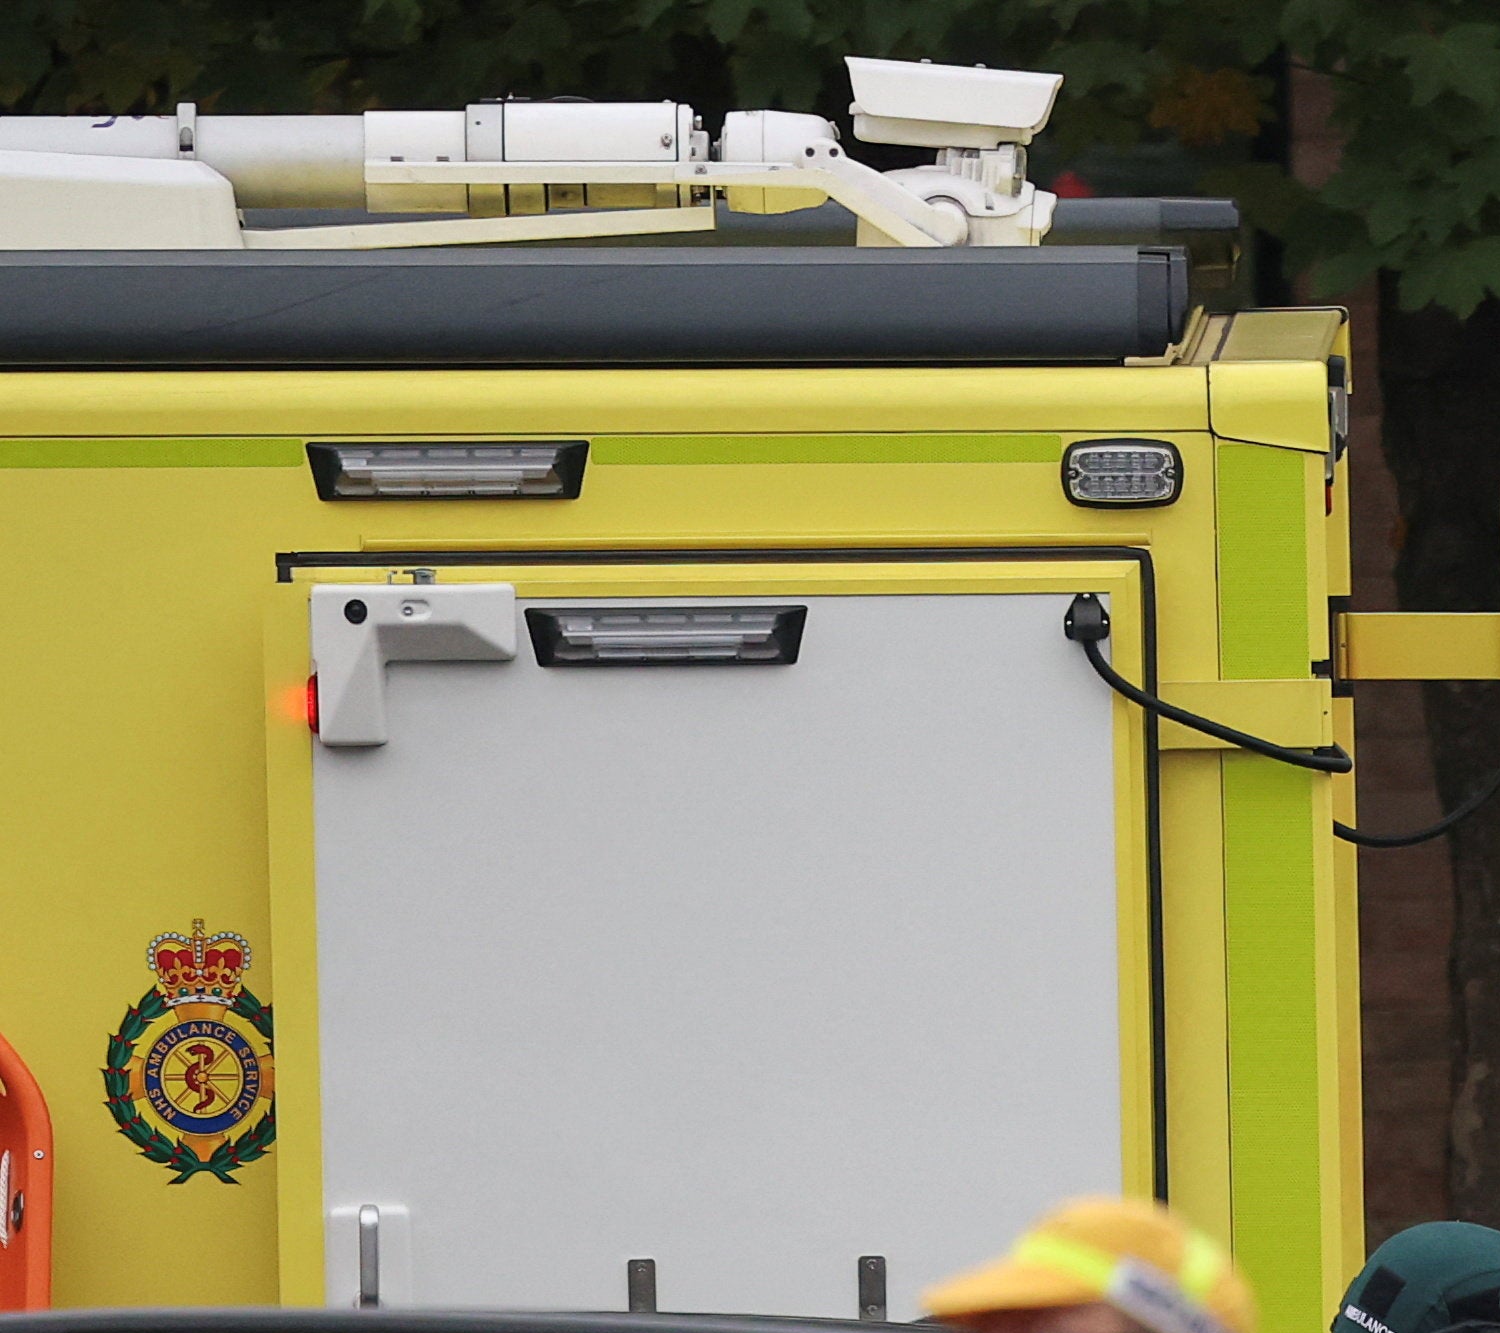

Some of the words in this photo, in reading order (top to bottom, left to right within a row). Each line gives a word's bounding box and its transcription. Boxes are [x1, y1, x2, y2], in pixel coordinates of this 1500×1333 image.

[147, 1022, 237, 1078] AMBULANCE
[149, 1087, 177, 1121] NHS
[229, 1046, 260, 1121] SERVICE
